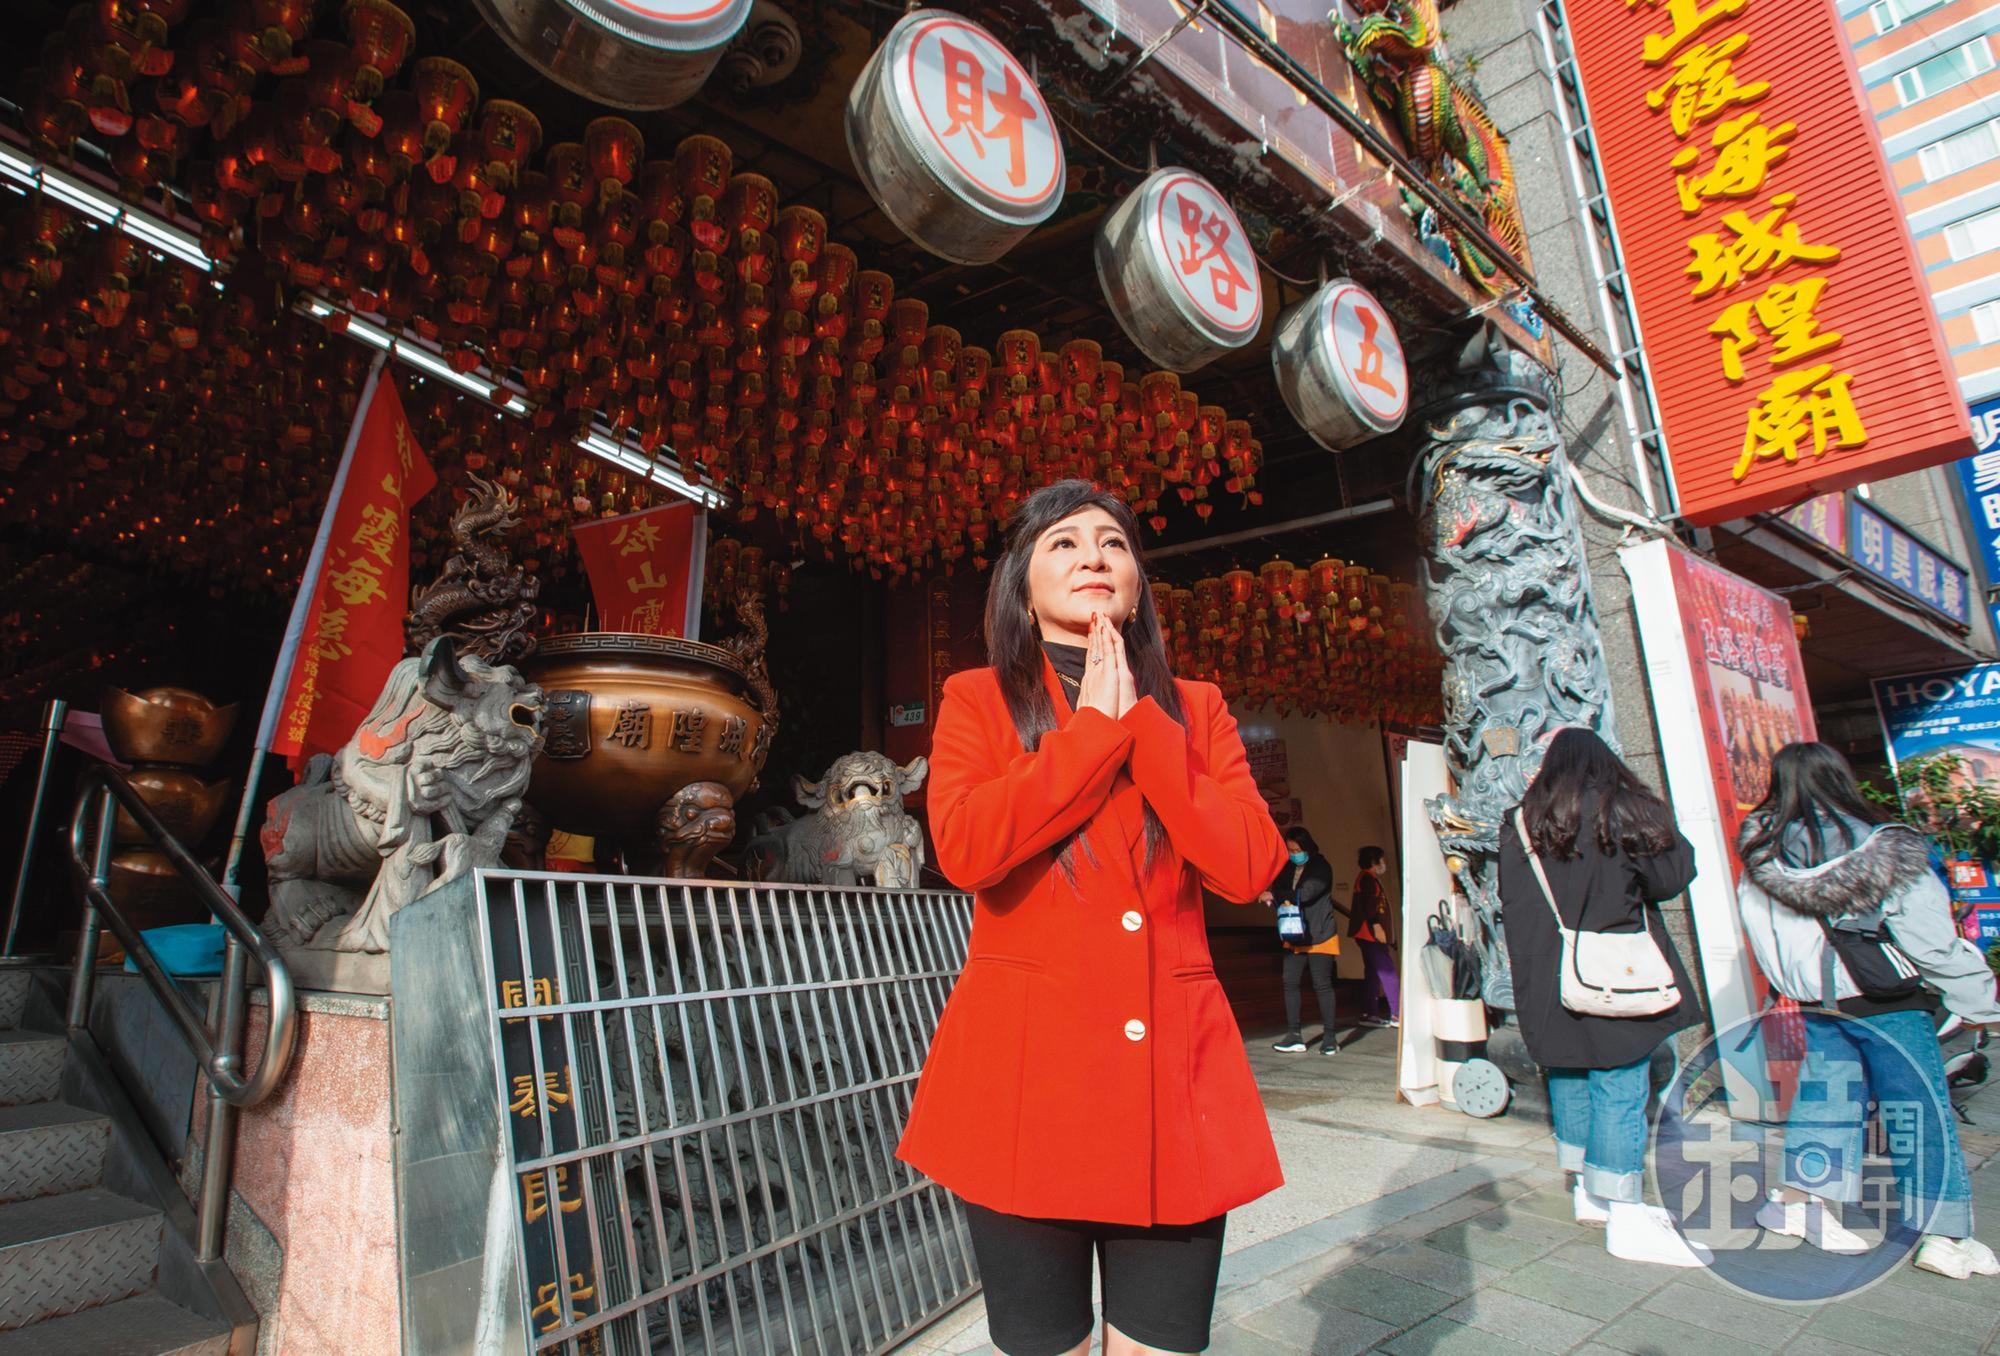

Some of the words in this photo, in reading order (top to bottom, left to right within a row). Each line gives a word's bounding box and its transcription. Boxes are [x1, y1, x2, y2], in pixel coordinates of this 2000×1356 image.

[938, 37, 1039, 189] 財
[1176, 191, 1252, 312] 路
[1625, 0, 1869, 481] 山霞海城隍廟
[1352, 305, 1398, 399] 五
